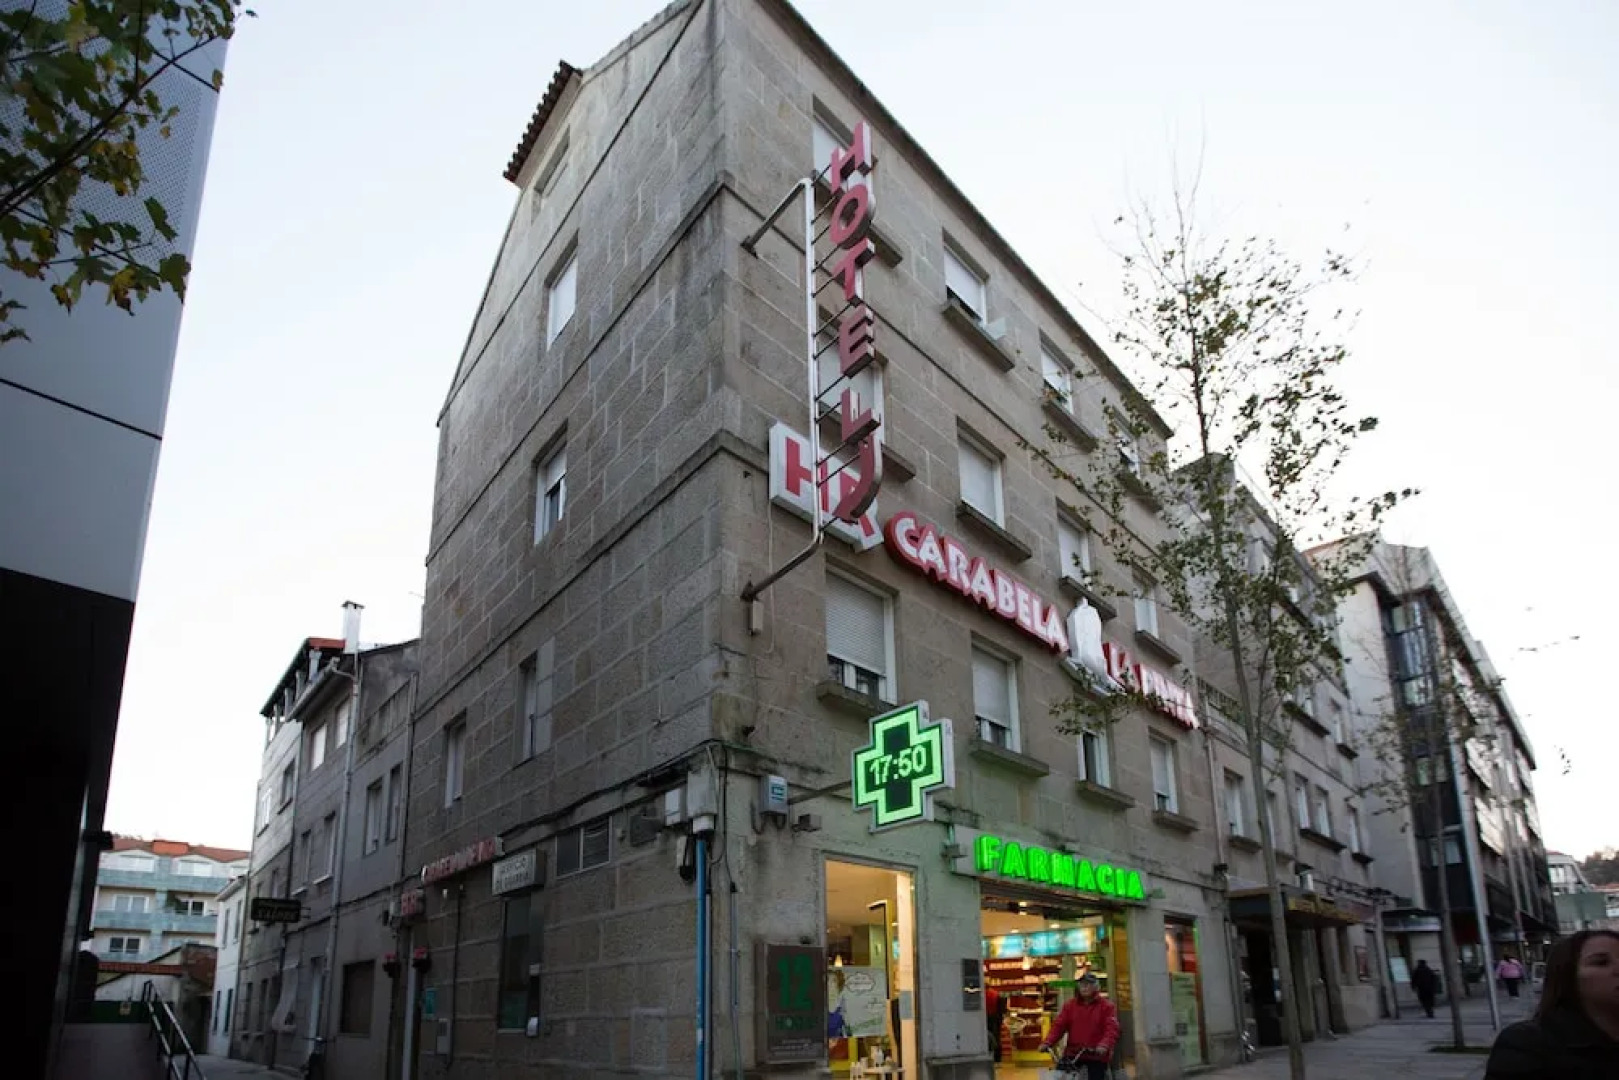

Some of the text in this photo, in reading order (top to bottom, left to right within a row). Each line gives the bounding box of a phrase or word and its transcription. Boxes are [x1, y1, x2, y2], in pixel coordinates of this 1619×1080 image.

[830, 120, 877, 443] HOTEL
[886, 512, 1068, 654] CARABELA
[868, 744, 927, 786] 17:50
[975, 834, 1144, 900] FARMACIA
[777, 952, 814, 1012] 12
